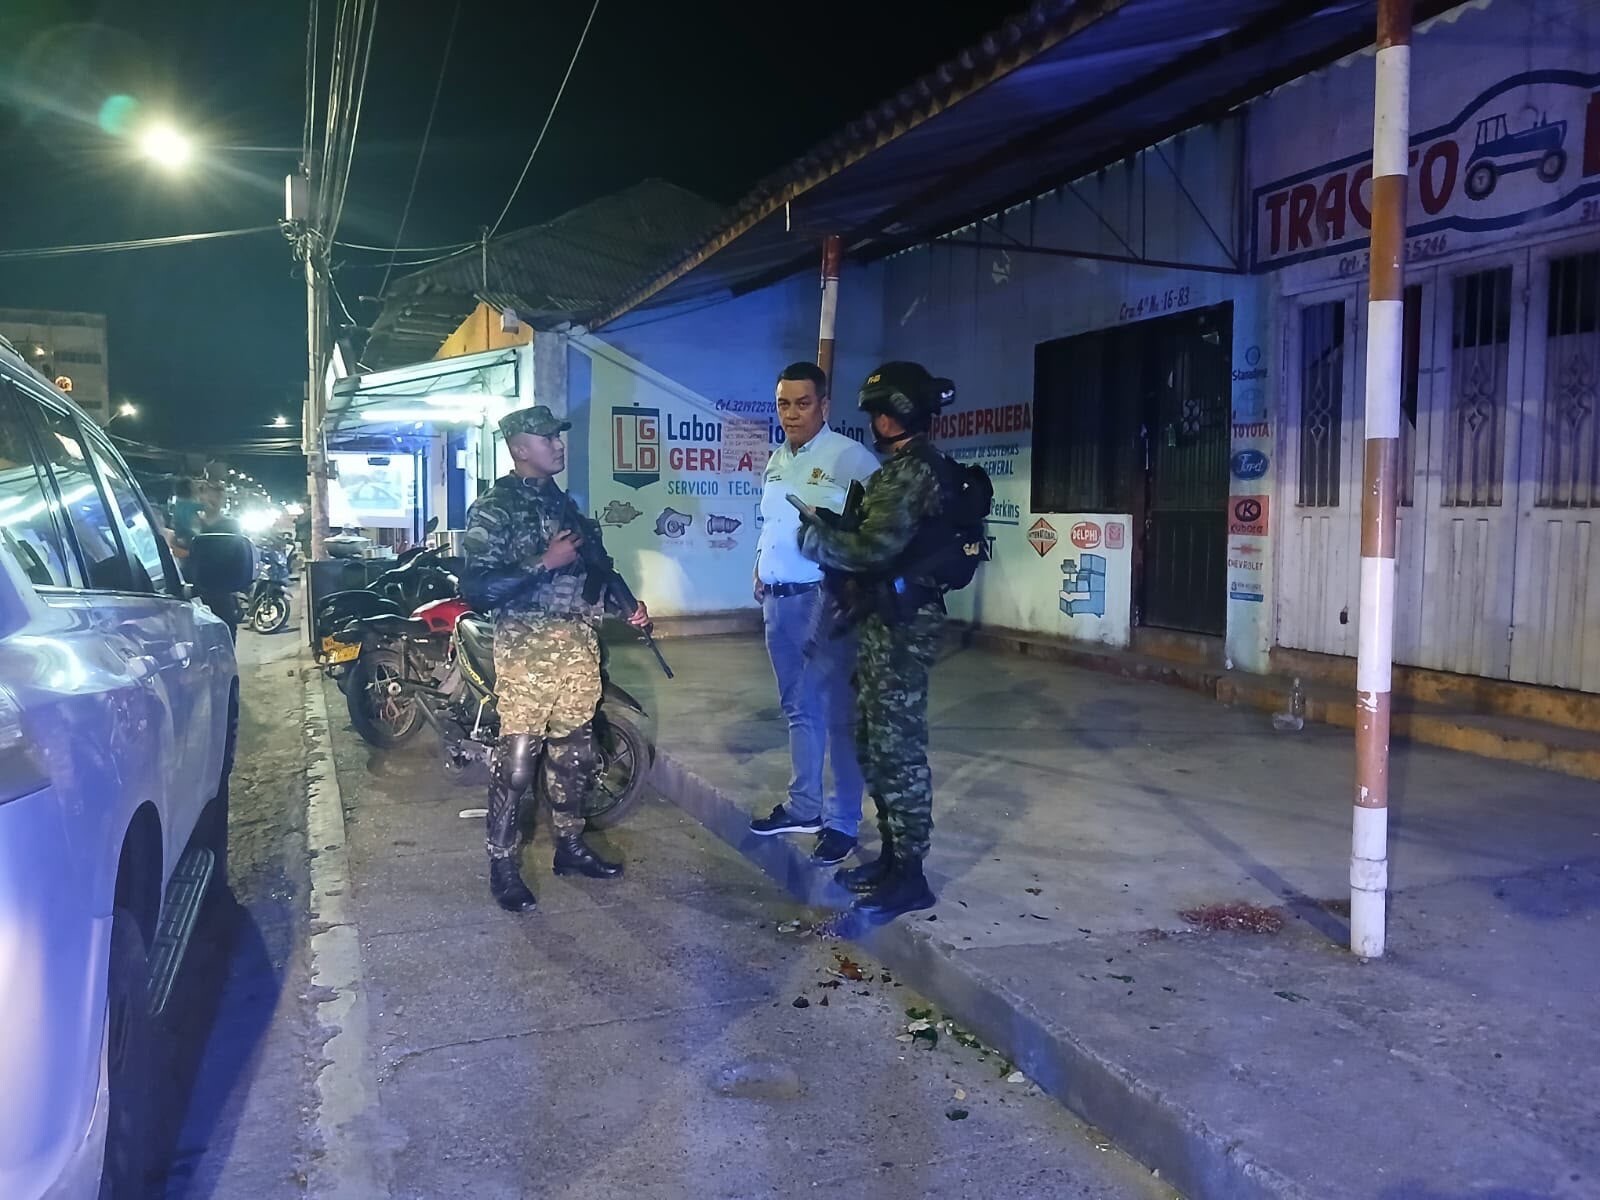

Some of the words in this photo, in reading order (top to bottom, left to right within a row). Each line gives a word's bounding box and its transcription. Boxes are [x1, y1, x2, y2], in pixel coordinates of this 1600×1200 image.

[1265, 140, 1458, 256] TRACO
[1163, 286, 1190, 310] 16-83
[1233, 422, 1270, 438] TOYOTA
[1239, 453, 1264, 473] Ford
[667, 480, 719, 497] SERVICIO
[990, 498, 1020, 519] Perkins
[1073, 529, 1098, 542] DELPHI
[1228, 559, 1264, 571] CHEVROLET
